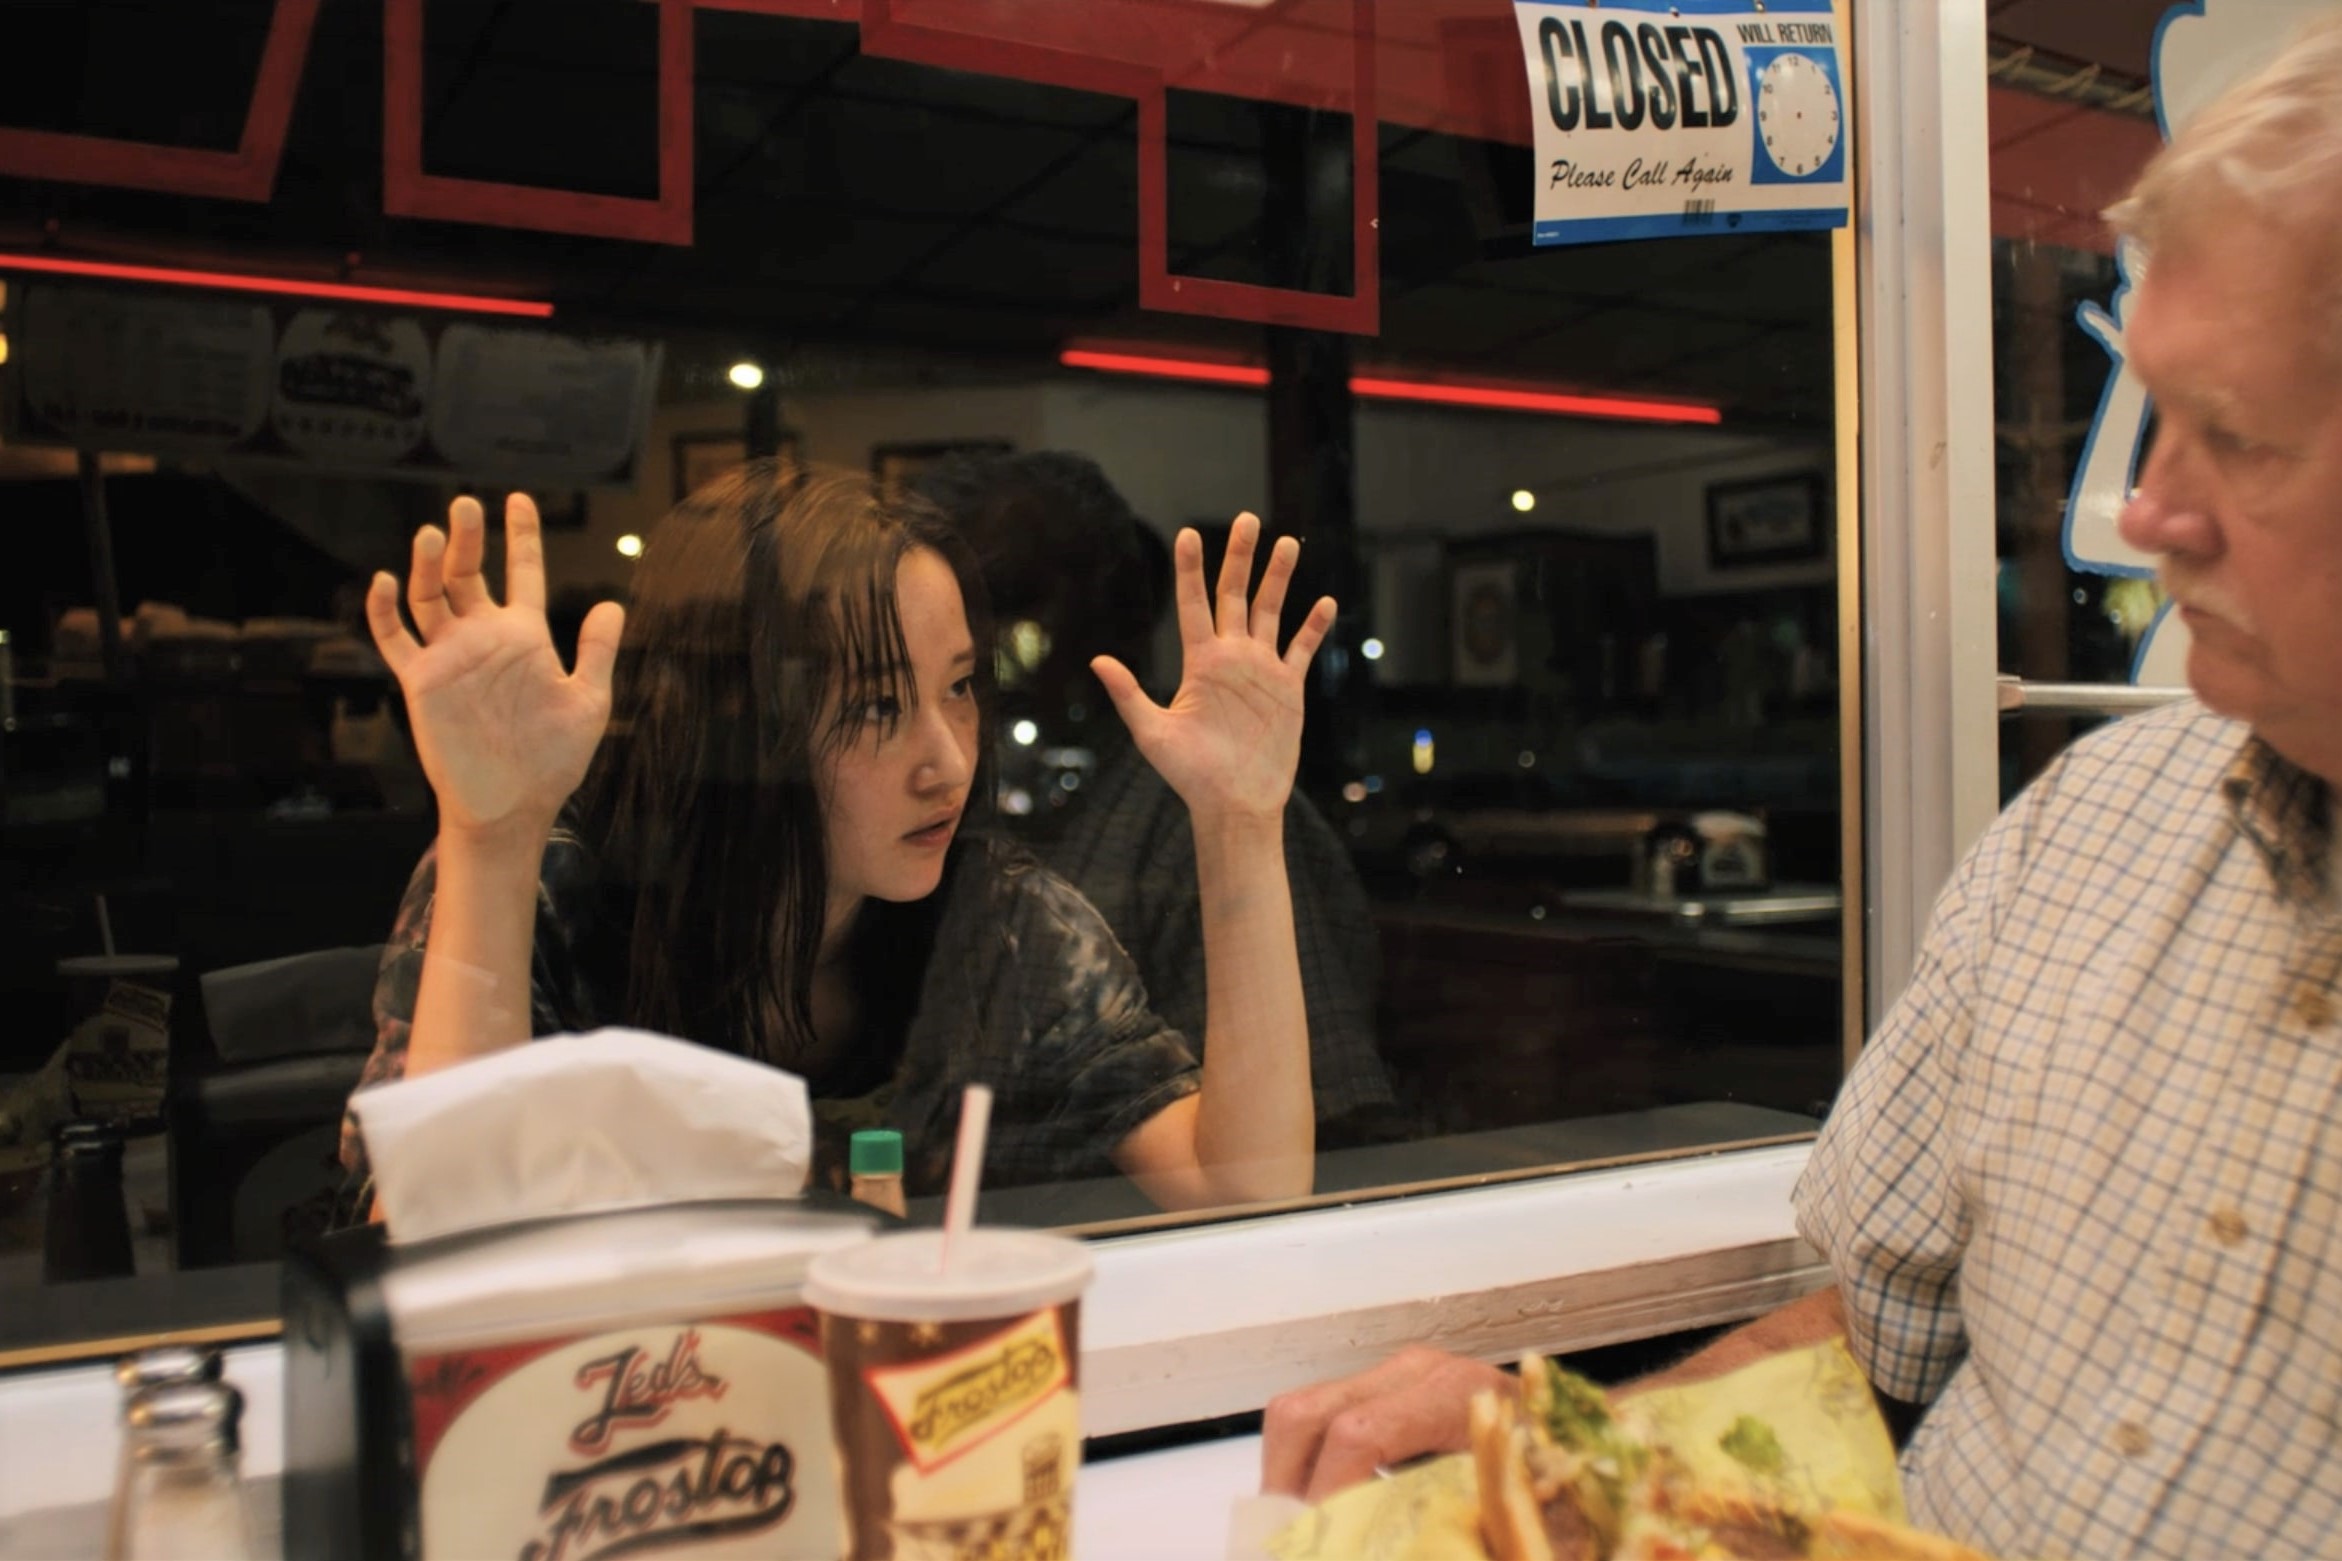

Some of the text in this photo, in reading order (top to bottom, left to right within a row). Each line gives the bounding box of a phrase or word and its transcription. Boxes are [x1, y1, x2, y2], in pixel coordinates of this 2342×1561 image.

[1737, 24, 1833, 43] WILL RETURN
[1787, 55, 1799, 67] 12
[1539, 16, 1738, 131] CLOSED
[1763, 83, 1774, 95] 10
[1550, 156, 1734, 193] Please Call Again
